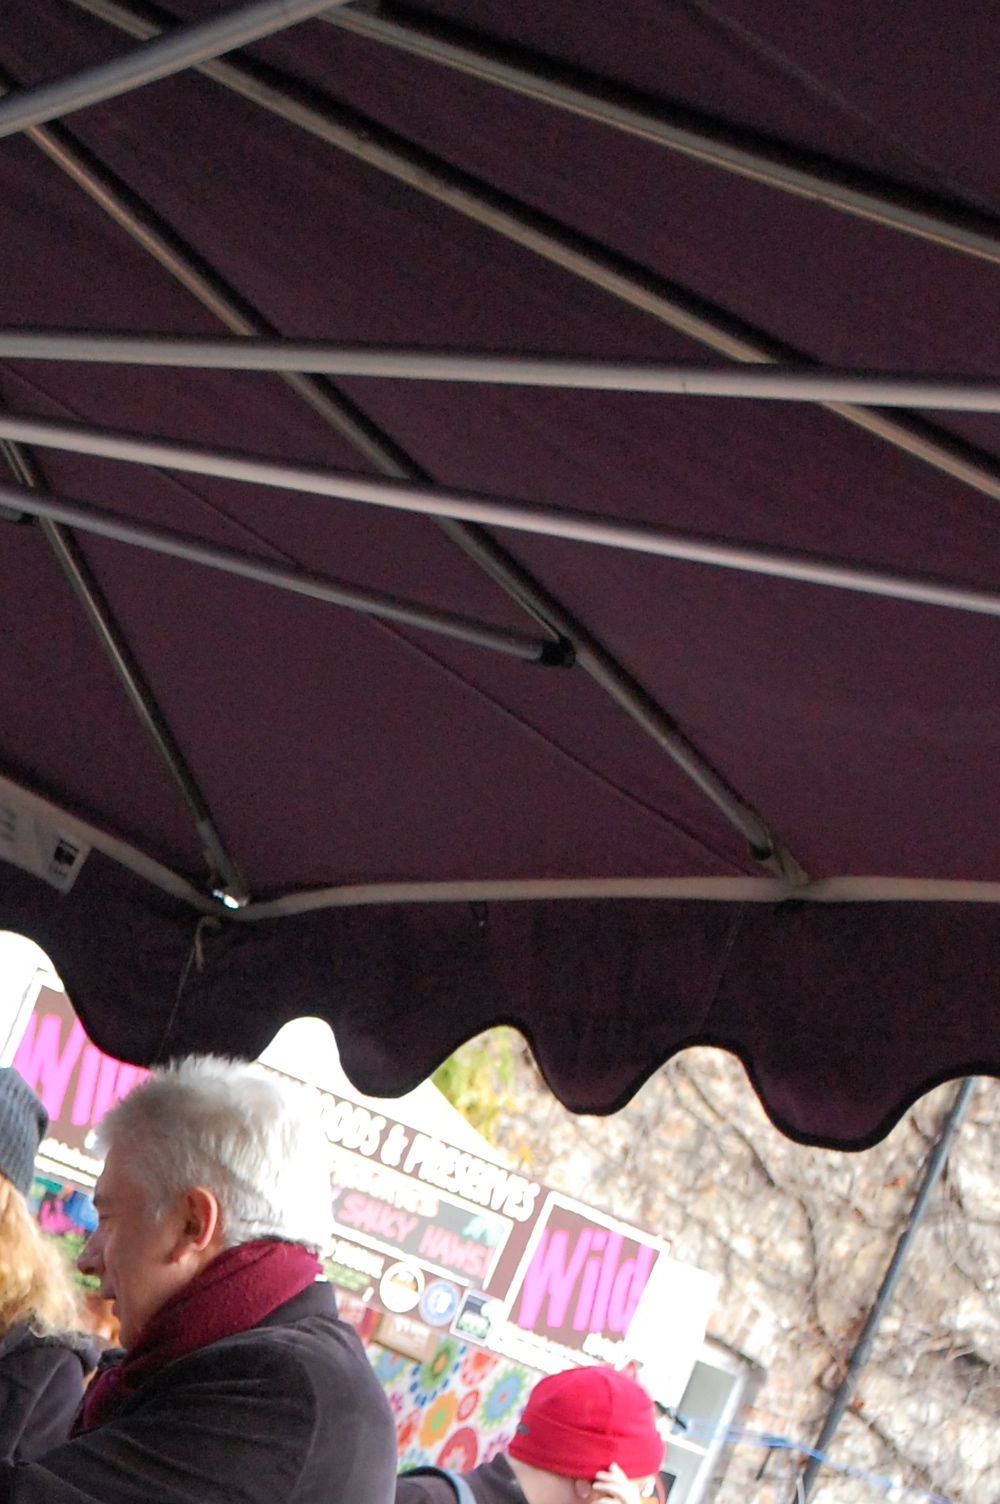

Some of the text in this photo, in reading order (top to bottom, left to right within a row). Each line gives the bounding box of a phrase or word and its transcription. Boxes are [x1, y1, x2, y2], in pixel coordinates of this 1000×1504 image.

[380, 1123, 409, 1168] &
[402, 1133, 541, 1222] PRESERVES
[517, 1225, 654, 1333] Wild
